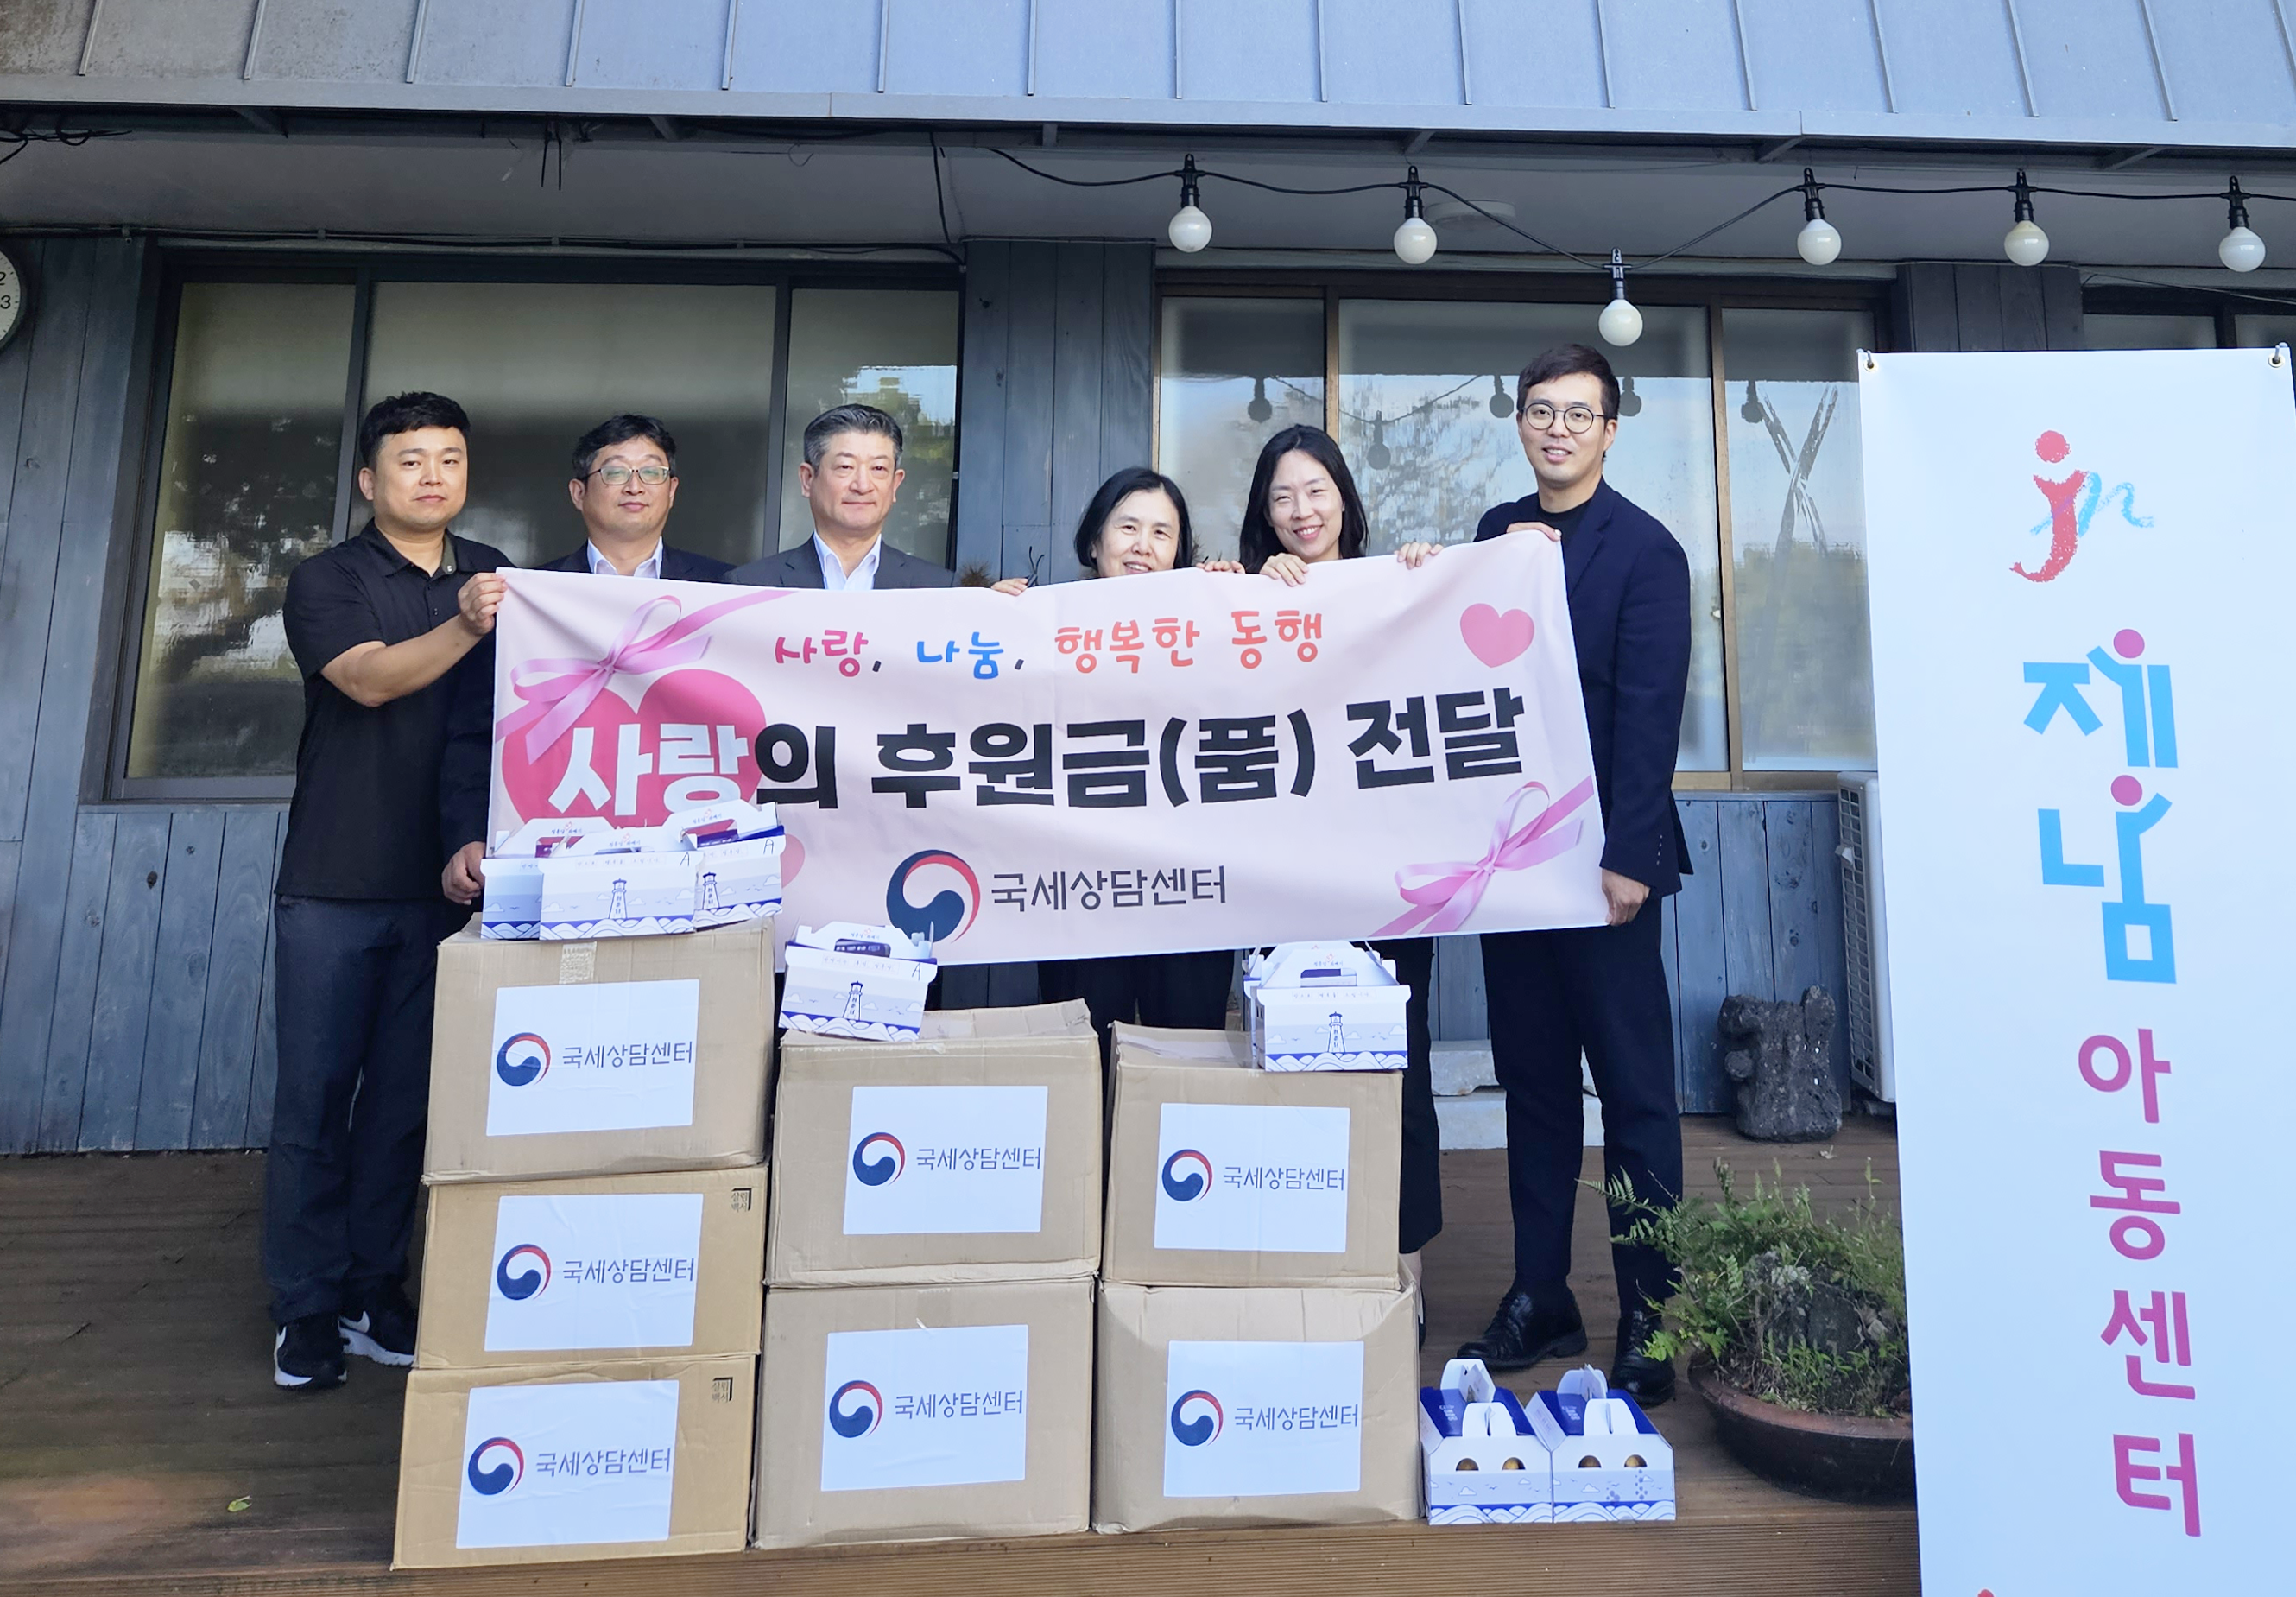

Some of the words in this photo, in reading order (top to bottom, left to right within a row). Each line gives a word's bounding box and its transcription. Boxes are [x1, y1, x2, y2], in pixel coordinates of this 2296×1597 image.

[0, 295, 11, 310] 3
[775, 630, 882, 678] 사랑,
[916, 631, 1025, 681] 나눔,
[1054, 618, 1200, 674] 행복한
[1231, 610, 1323, 669] 동행
[547, 723, 839, 816] 사랑의
[871, 708, 1316, 810] 후원금(품)
[1345, 687, 1526, 790] 전달
[990, 865, 1227, 913] 국세상담센터
[562, 1041, 693, 1069] 국세상담센터
[916, 1147, 1041, 1171] 국세상담센터
[1223, 1166, 1345, 1191] 국세상담센터
[562, 1258, 695, 1284] 국세상담센터
[894, 1389, 1023, 1420] 국세상담센터
[1234, 1404, 1358, 1431] 국세상담센터
[535, 1448, 671, 1478] 국세상담센터
